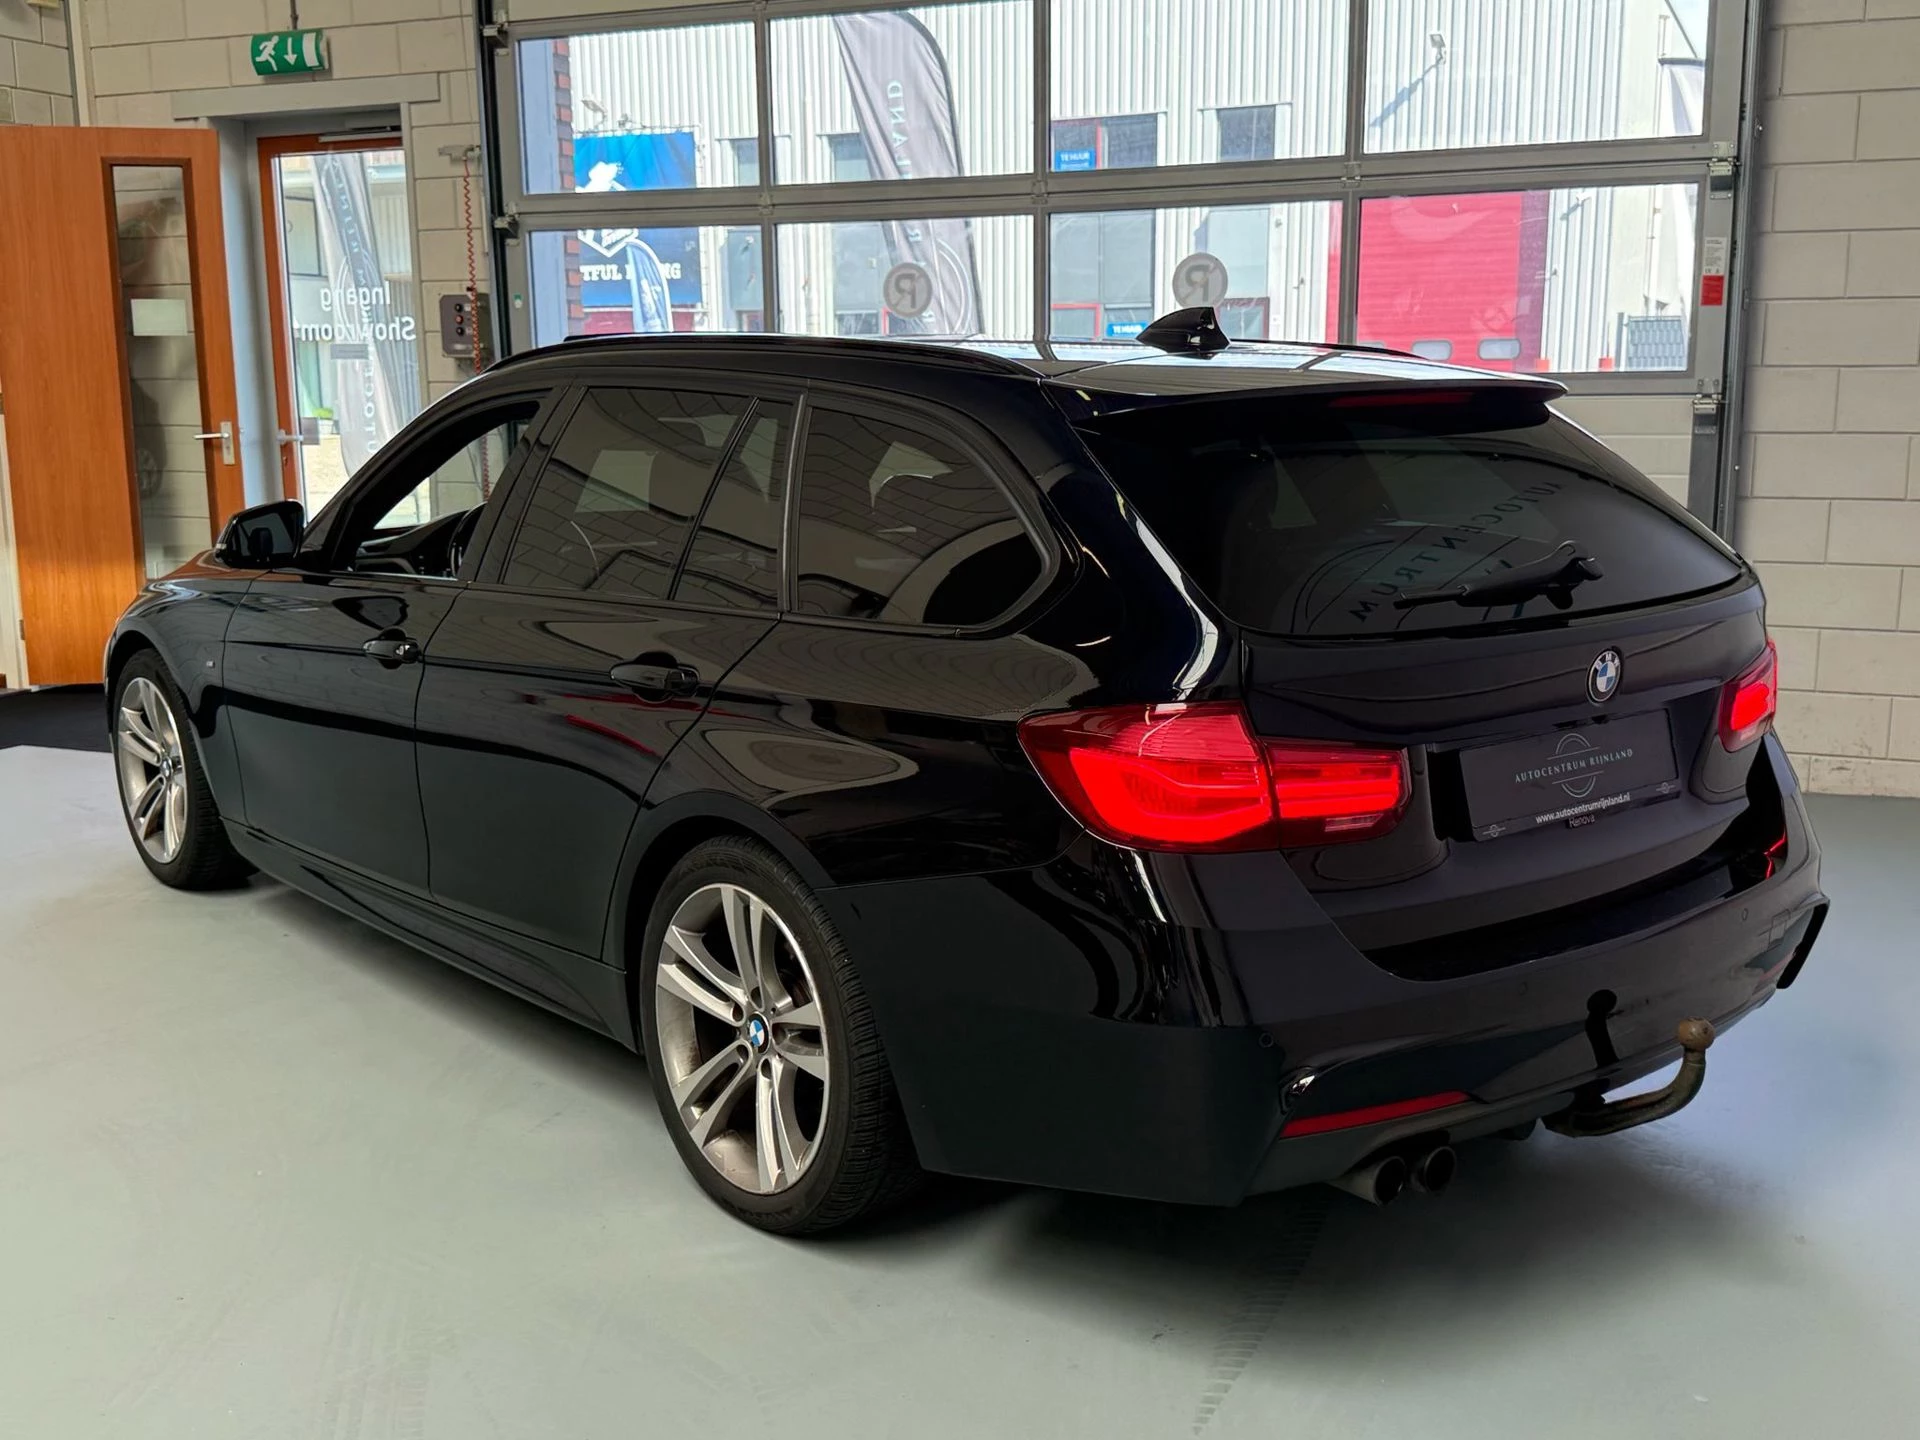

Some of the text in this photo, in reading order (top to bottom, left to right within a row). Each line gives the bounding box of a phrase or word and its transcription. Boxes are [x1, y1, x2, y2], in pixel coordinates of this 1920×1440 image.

[1515, 748, 1634, 783] AUTOCENTRUM RIJNLAND
[1535, 792, 1631, 824] www.autocentrumrijnland.nl
